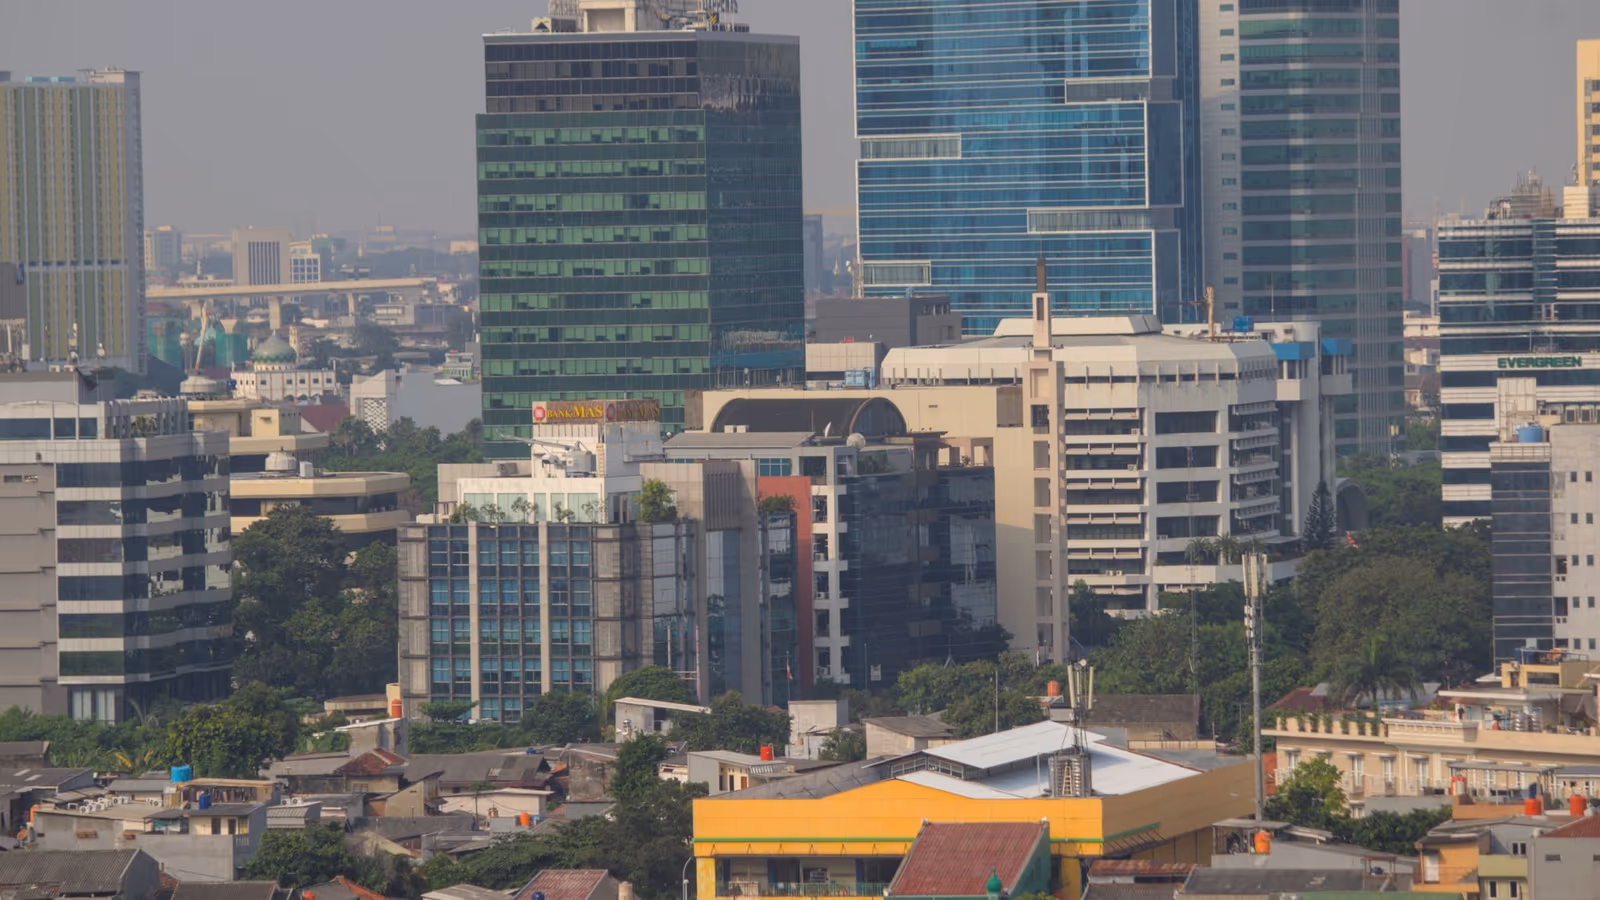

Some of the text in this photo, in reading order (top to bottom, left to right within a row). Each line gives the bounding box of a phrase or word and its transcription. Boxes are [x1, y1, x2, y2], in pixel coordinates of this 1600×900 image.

[1497, 356, 1582, 368] EVERGREEN
[546, 409, 572, 418] BANK
[573, 405, 603, 418] MAS
